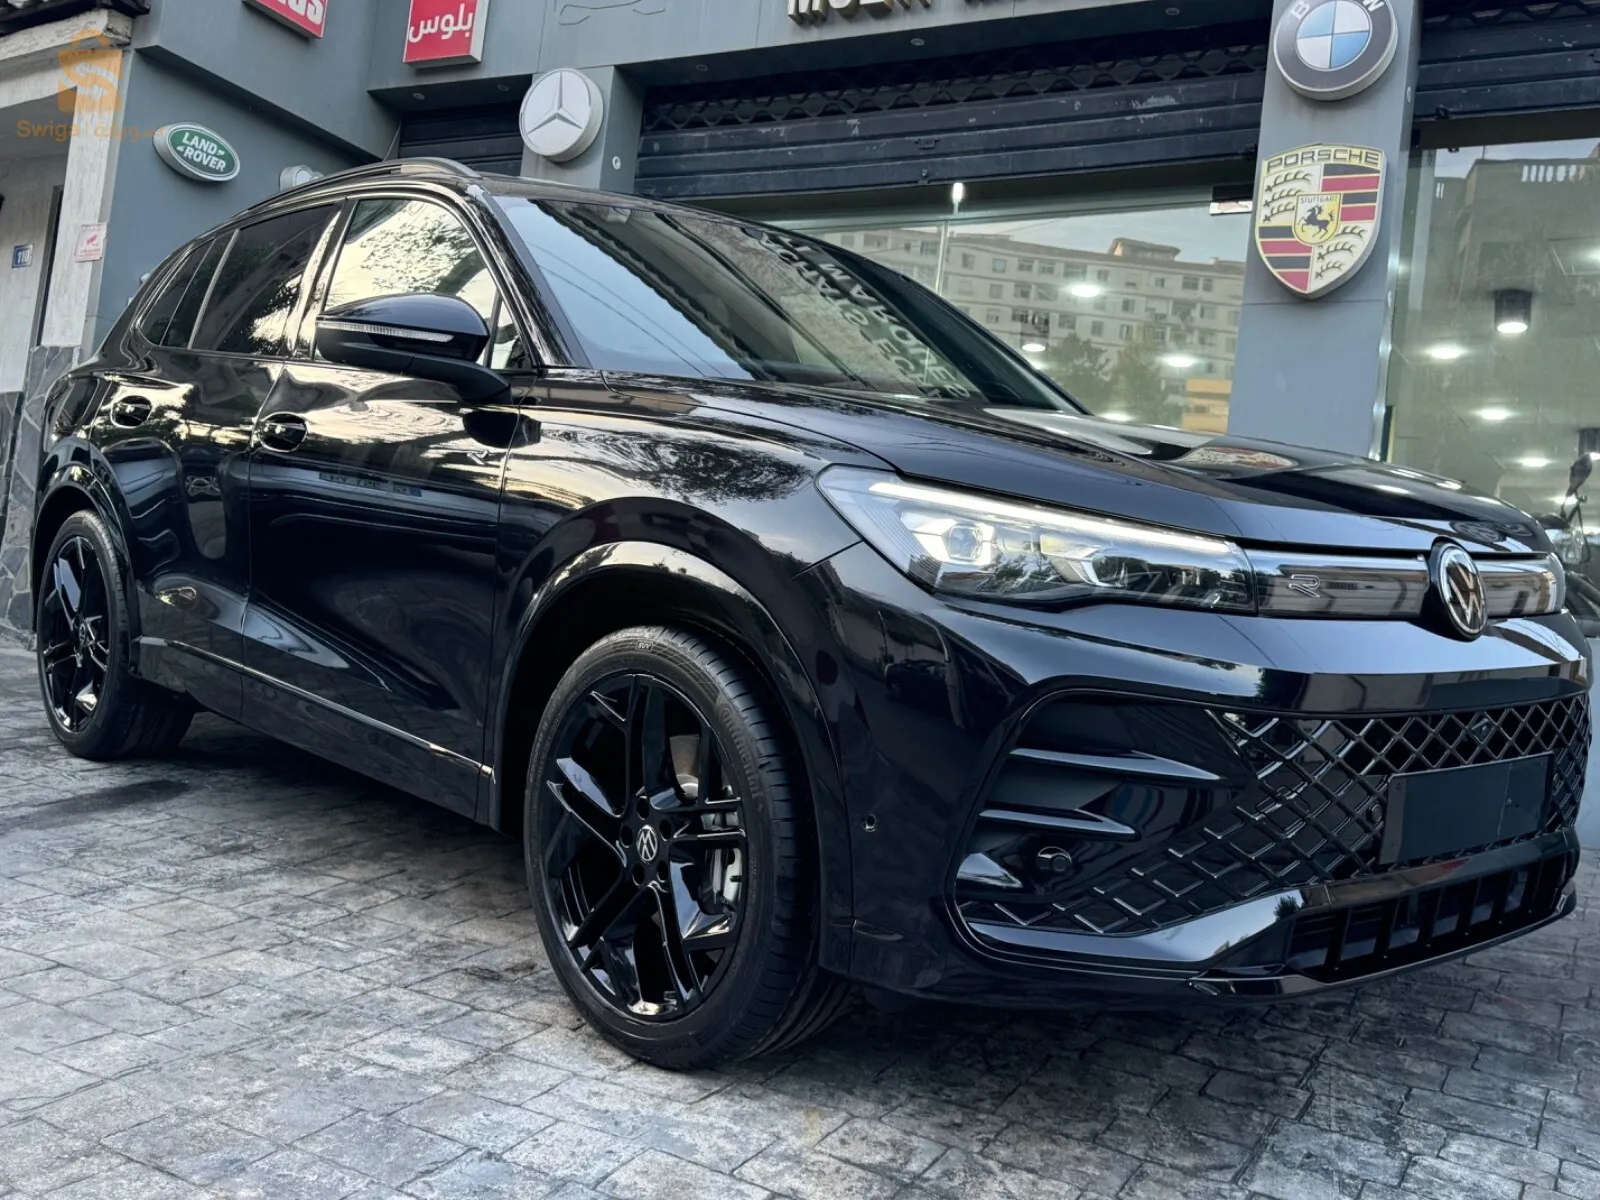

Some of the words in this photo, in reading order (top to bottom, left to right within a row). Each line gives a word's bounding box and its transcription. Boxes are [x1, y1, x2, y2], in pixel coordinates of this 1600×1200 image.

[182, 132, 218, 155] LAND
[183, 146, 226, 172] ROVER
[1267, 149, 1380, 173] PORSCHE
